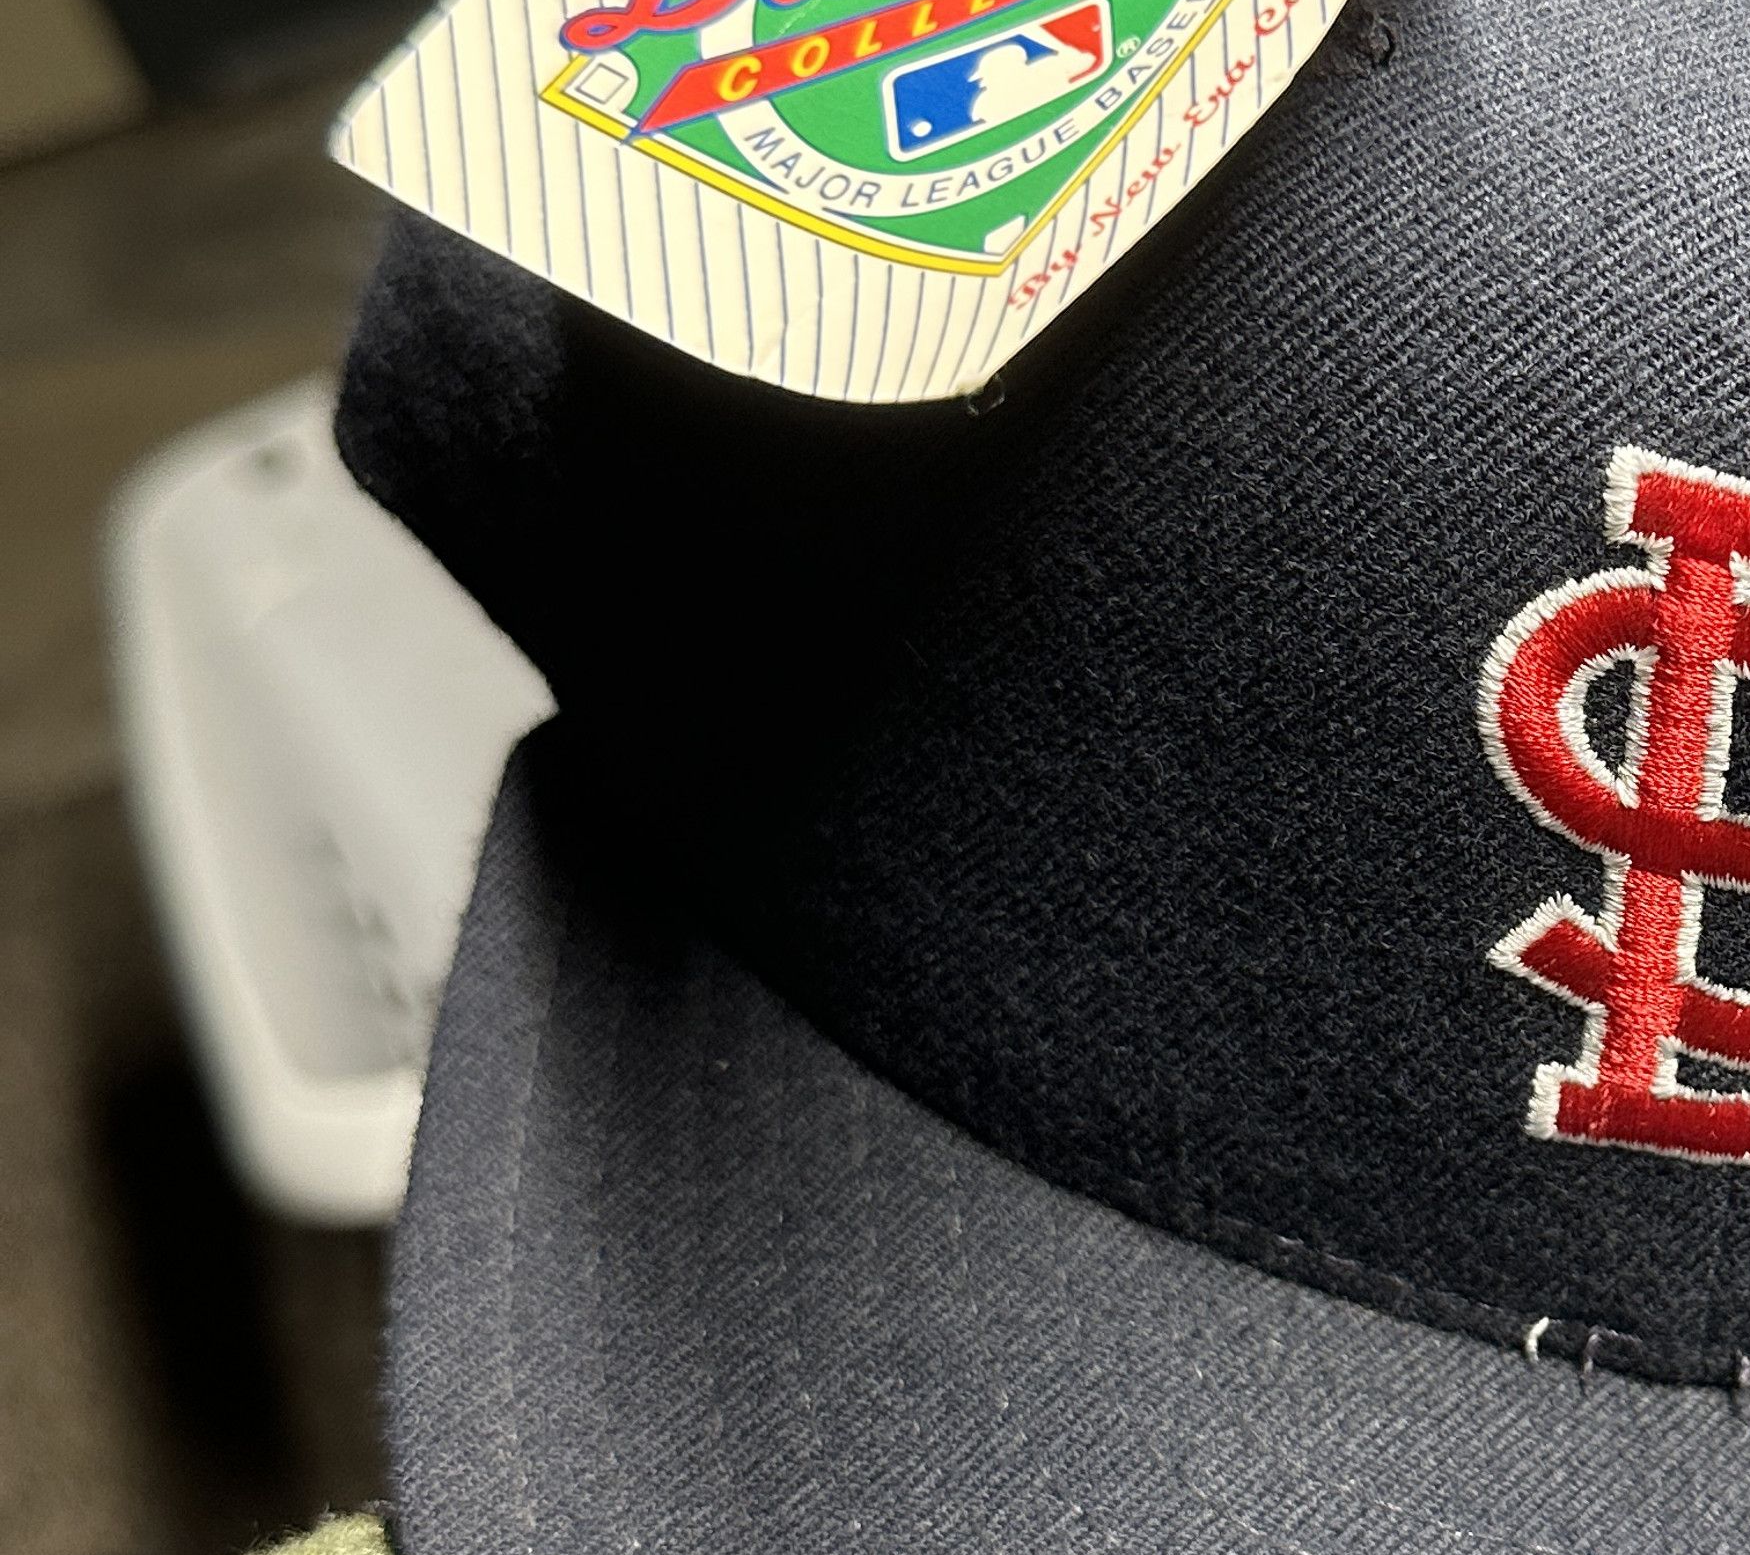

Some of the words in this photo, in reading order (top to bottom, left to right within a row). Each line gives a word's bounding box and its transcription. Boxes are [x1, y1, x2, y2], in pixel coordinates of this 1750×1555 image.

[744, 126, 882, 209] MAJOR
[900, 118, 1081, 208] LEAGUE
[1091, 143, 1181, 237] New
[1183, 55, 1255, 130] Era
